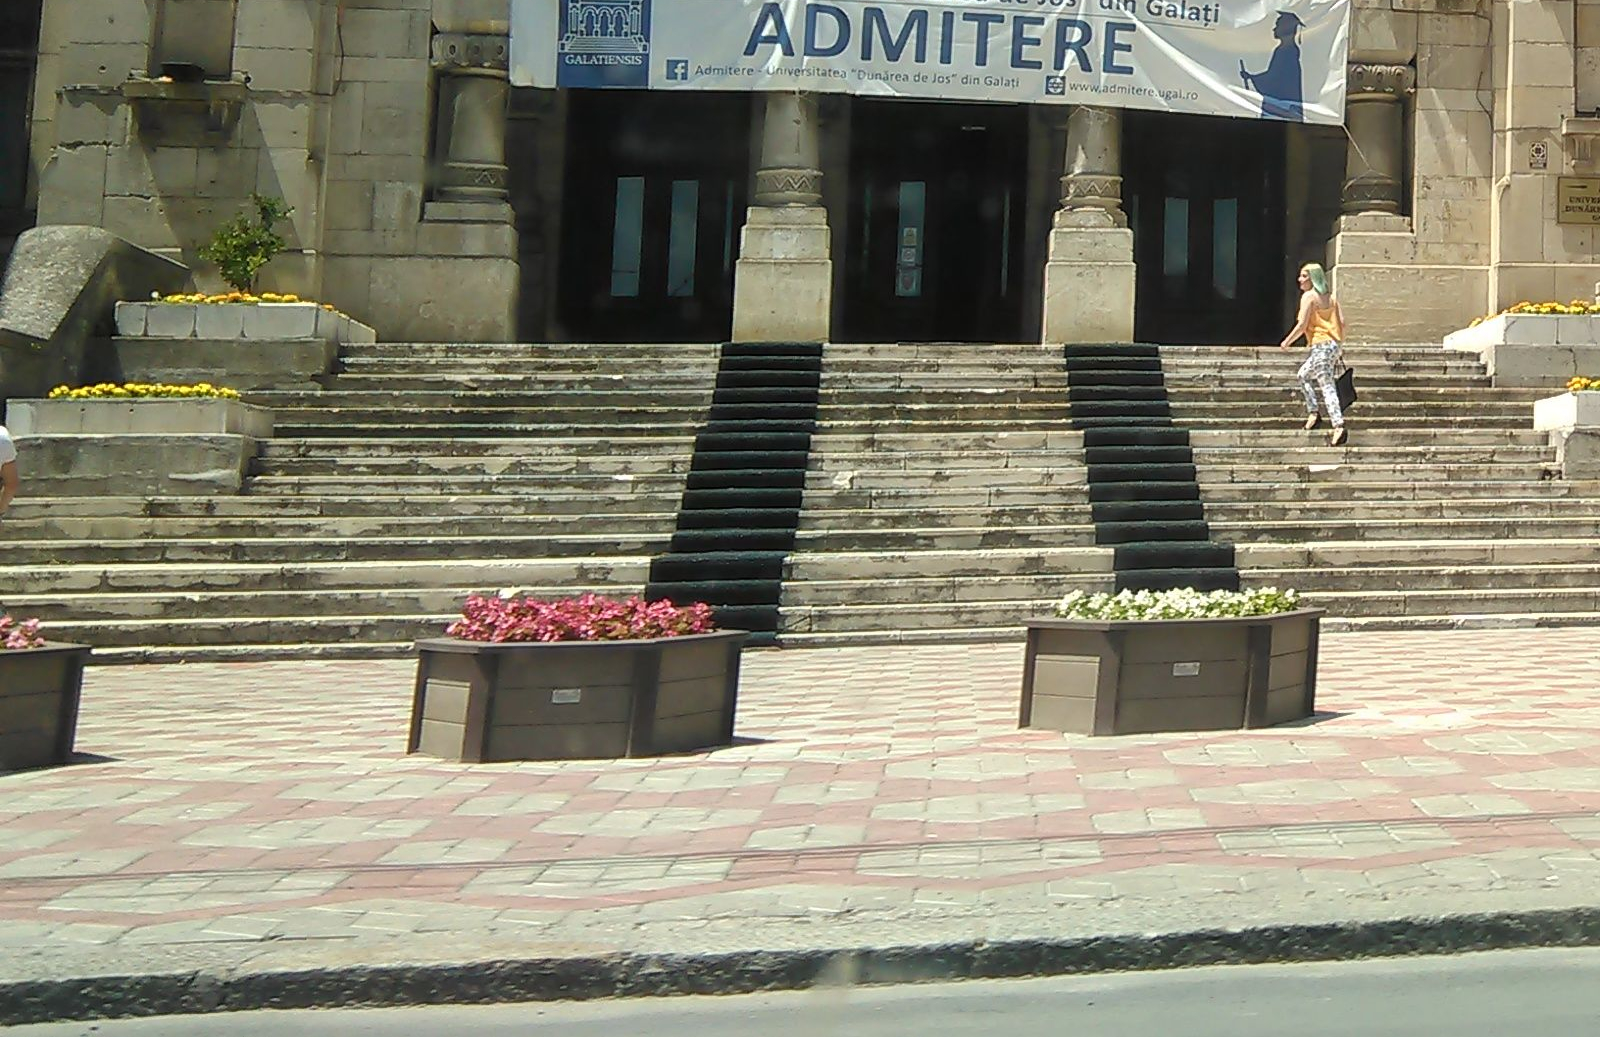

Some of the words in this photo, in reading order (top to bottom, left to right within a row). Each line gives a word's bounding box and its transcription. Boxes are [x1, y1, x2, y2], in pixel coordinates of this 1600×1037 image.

[742, 1, 1138, 76] ADMITERE
[564, 54, 643, 66] GALATIENSIS
[694, 64, 755, 76] Admitere
[766, 65, 847, 79] Universitatea
[913, 71, 928, 83] de
[960, 74, 980, 86] din
[1068, 81, 1199, 101] www.admitere.ugal.ro
